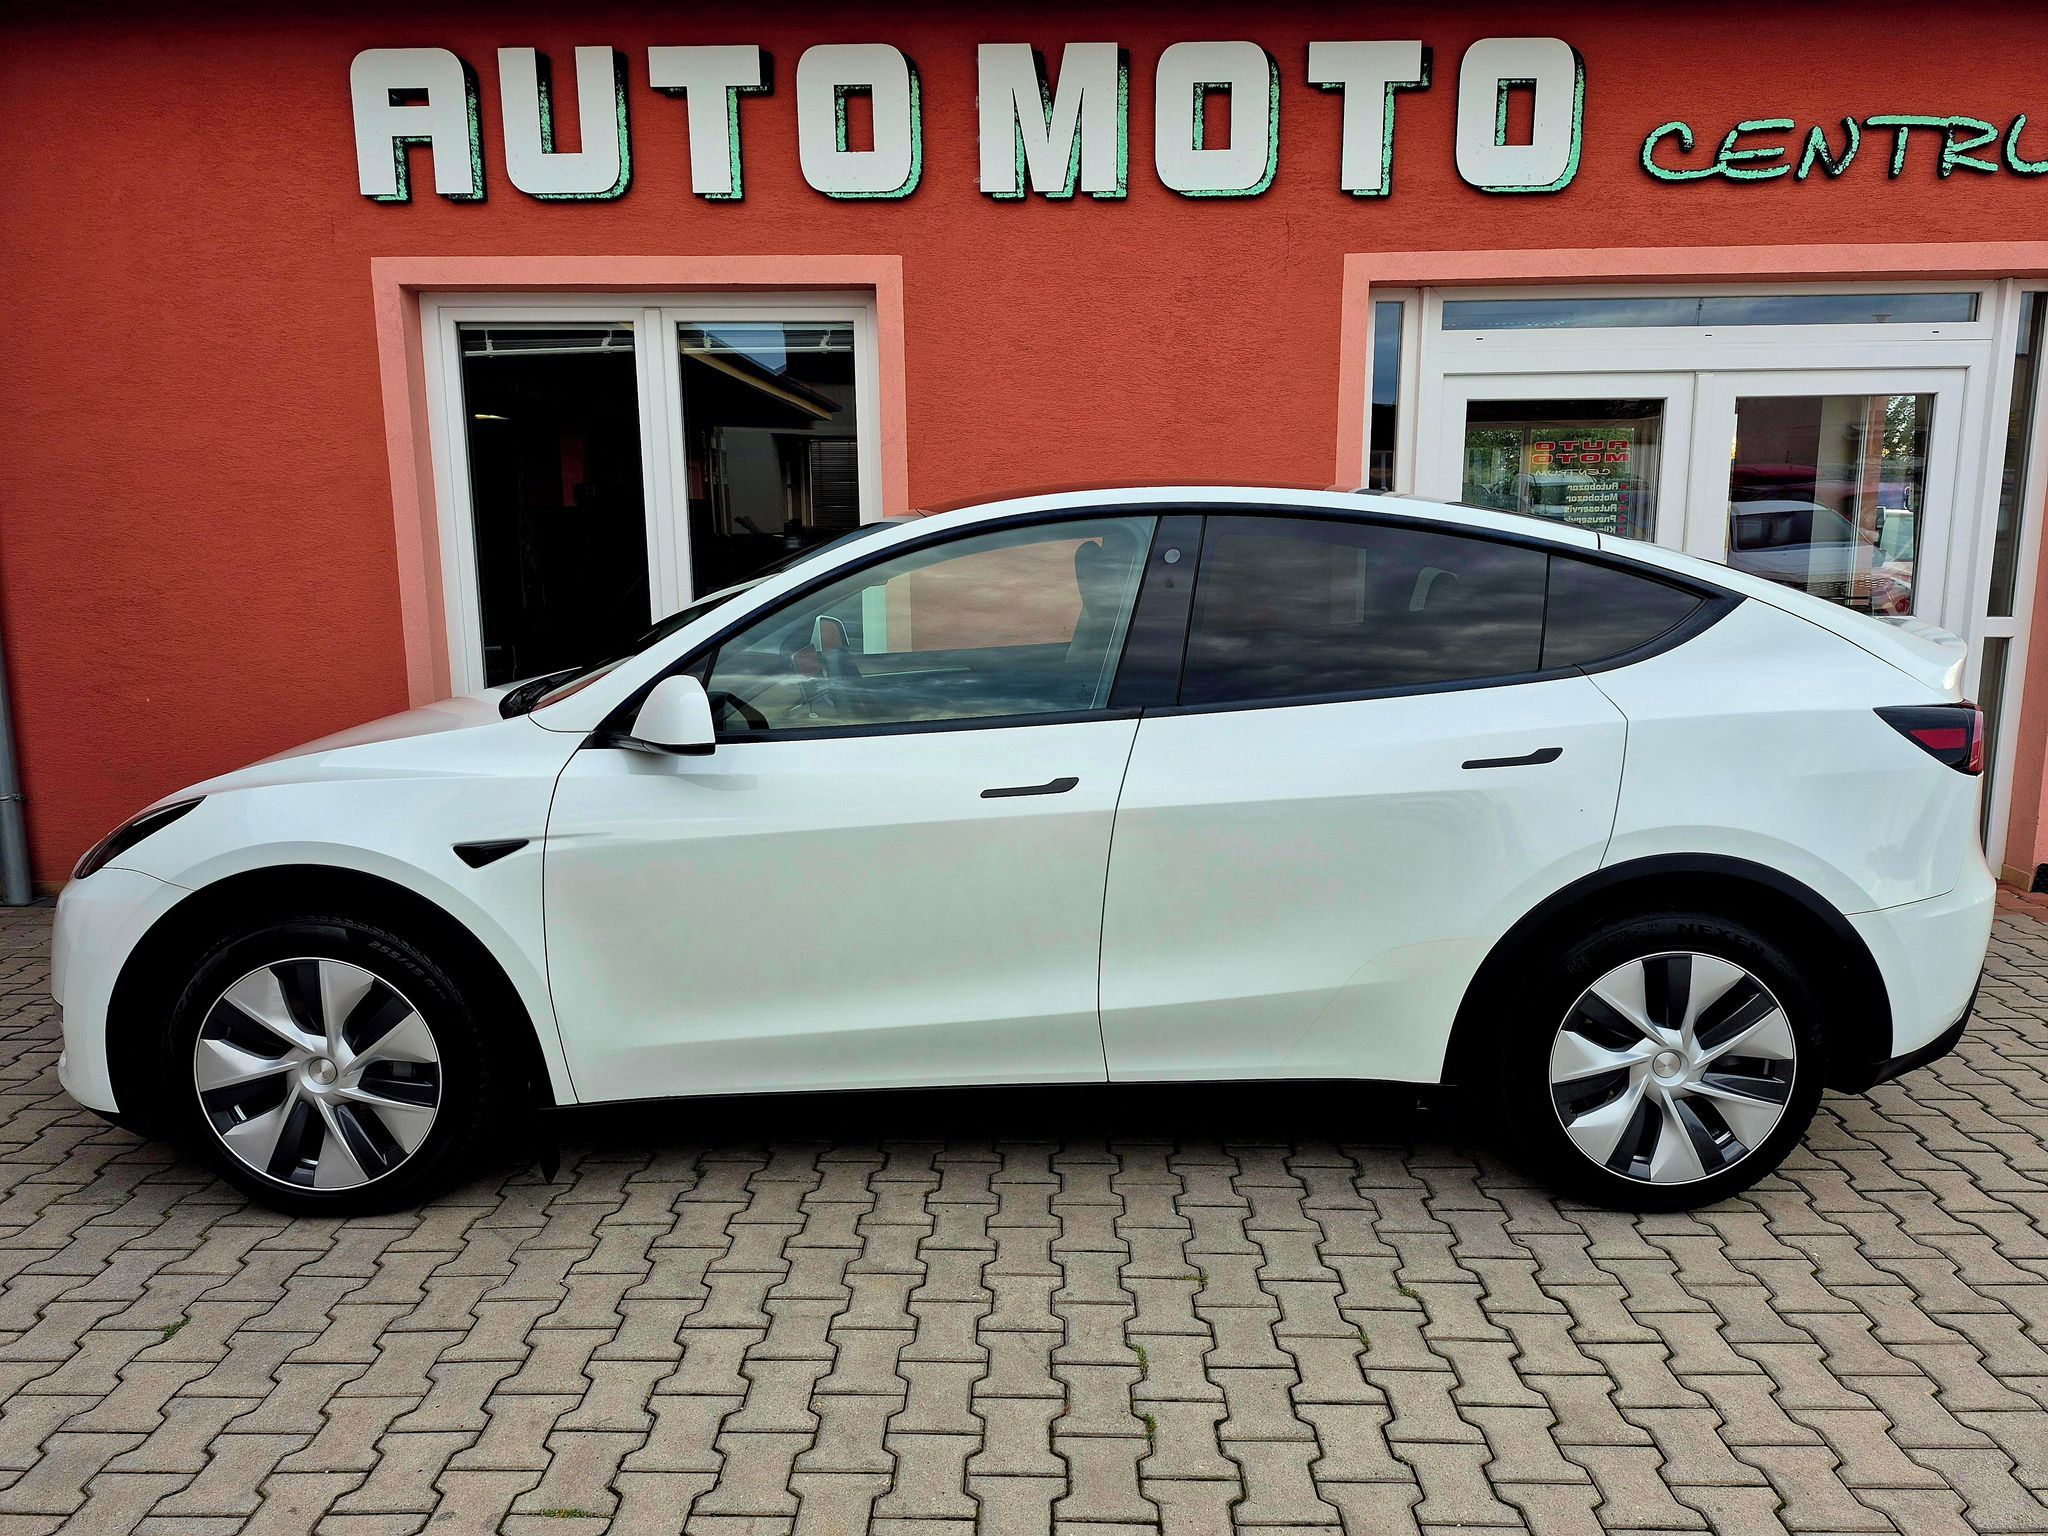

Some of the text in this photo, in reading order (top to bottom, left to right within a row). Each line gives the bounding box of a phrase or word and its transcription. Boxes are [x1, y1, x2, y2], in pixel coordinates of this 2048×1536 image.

[350, 43, 922, 202] AUTO
[978, 37, 1586, 200] MOTO
[1678, 923, 1762, 953] NEXEN
